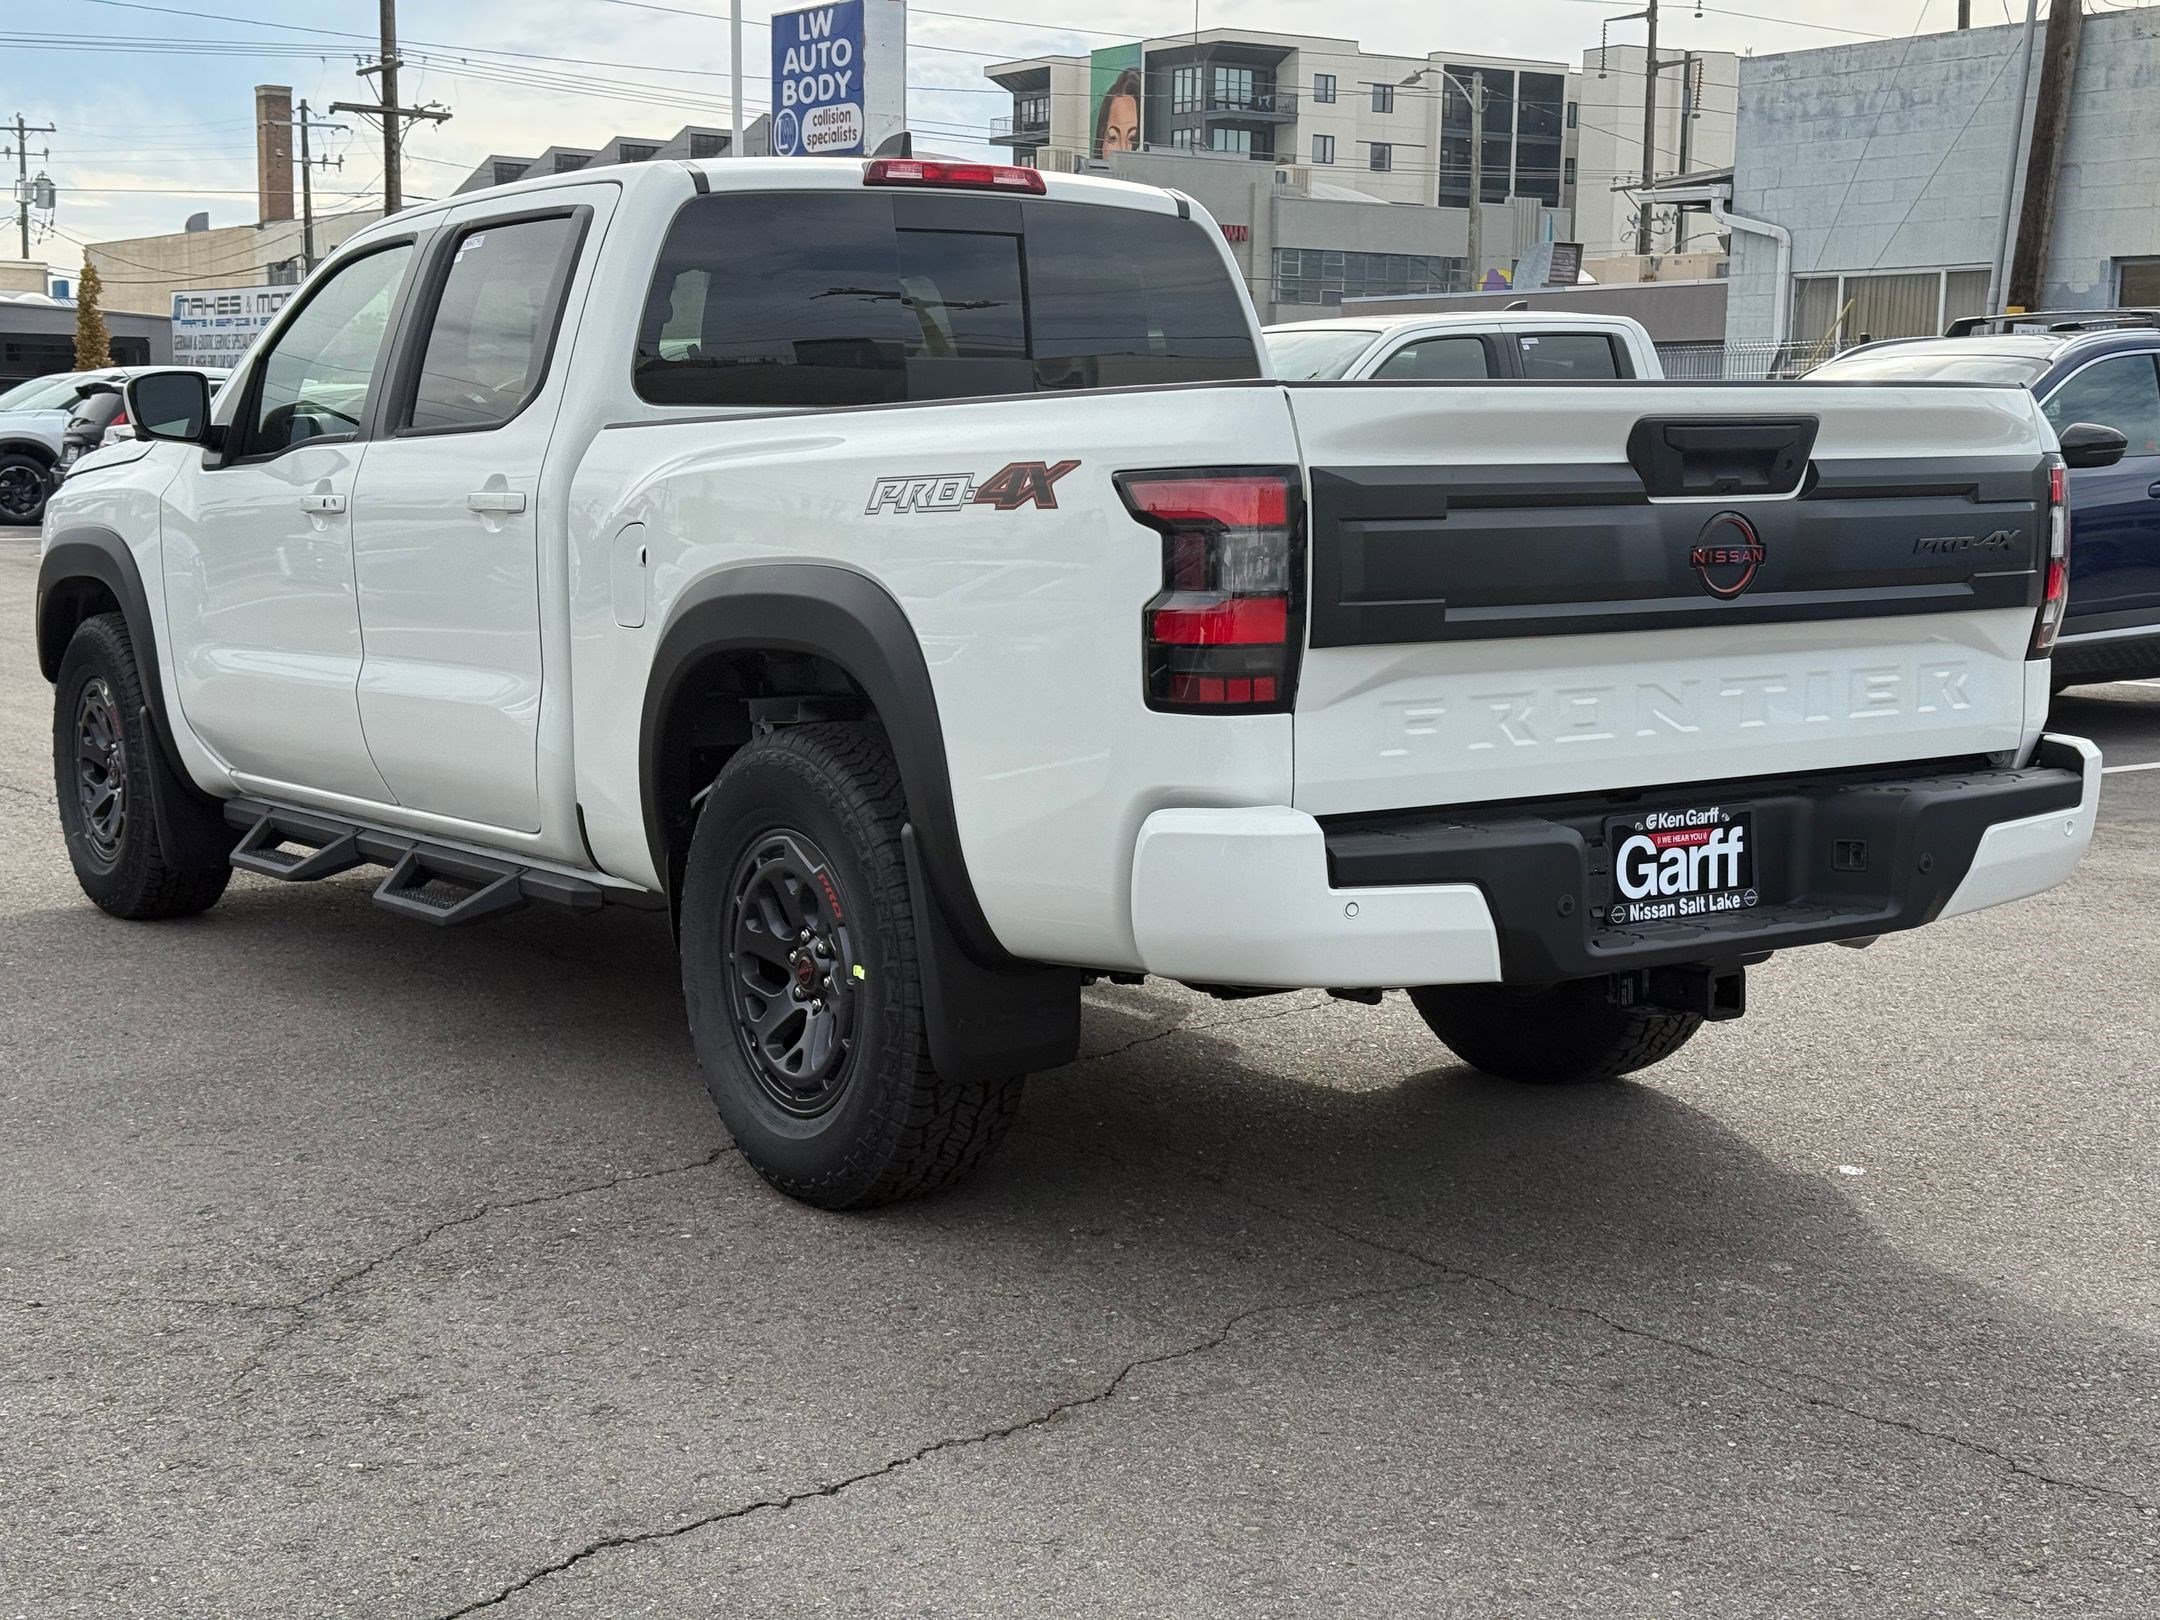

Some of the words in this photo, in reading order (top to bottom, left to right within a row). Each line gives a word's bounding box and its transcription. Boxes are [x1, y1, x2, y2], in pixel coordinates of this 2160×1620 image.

[799, 9, 833, 41] LW
[783, 38, 852, 76] AUTO
[783, 70, 852, 106] BODY
[812, 108, 851, 126] collision
[807, 126, 857, 150] specialists
[1222, 225, 1248, 241] WN
[1692, 549, 1763, 564] NISSAN
[1379, 660, 1972, 757] FRONTIER
[1658, 812, 1684, 829] Ken
[1686, 807, 1719, 826] Garff
[1662, 836, 1672, 844] WE
[1673, 834, 1689, 842] HEAR
[1690, 832, 1703, 841] YOU
[1616, 826, 1743, 900] Garff
[1629, 903, 1675, 921] Nissan
[1679, 897, 1705, 916] Salt
[1709, 892, 1740, 912] Lake
